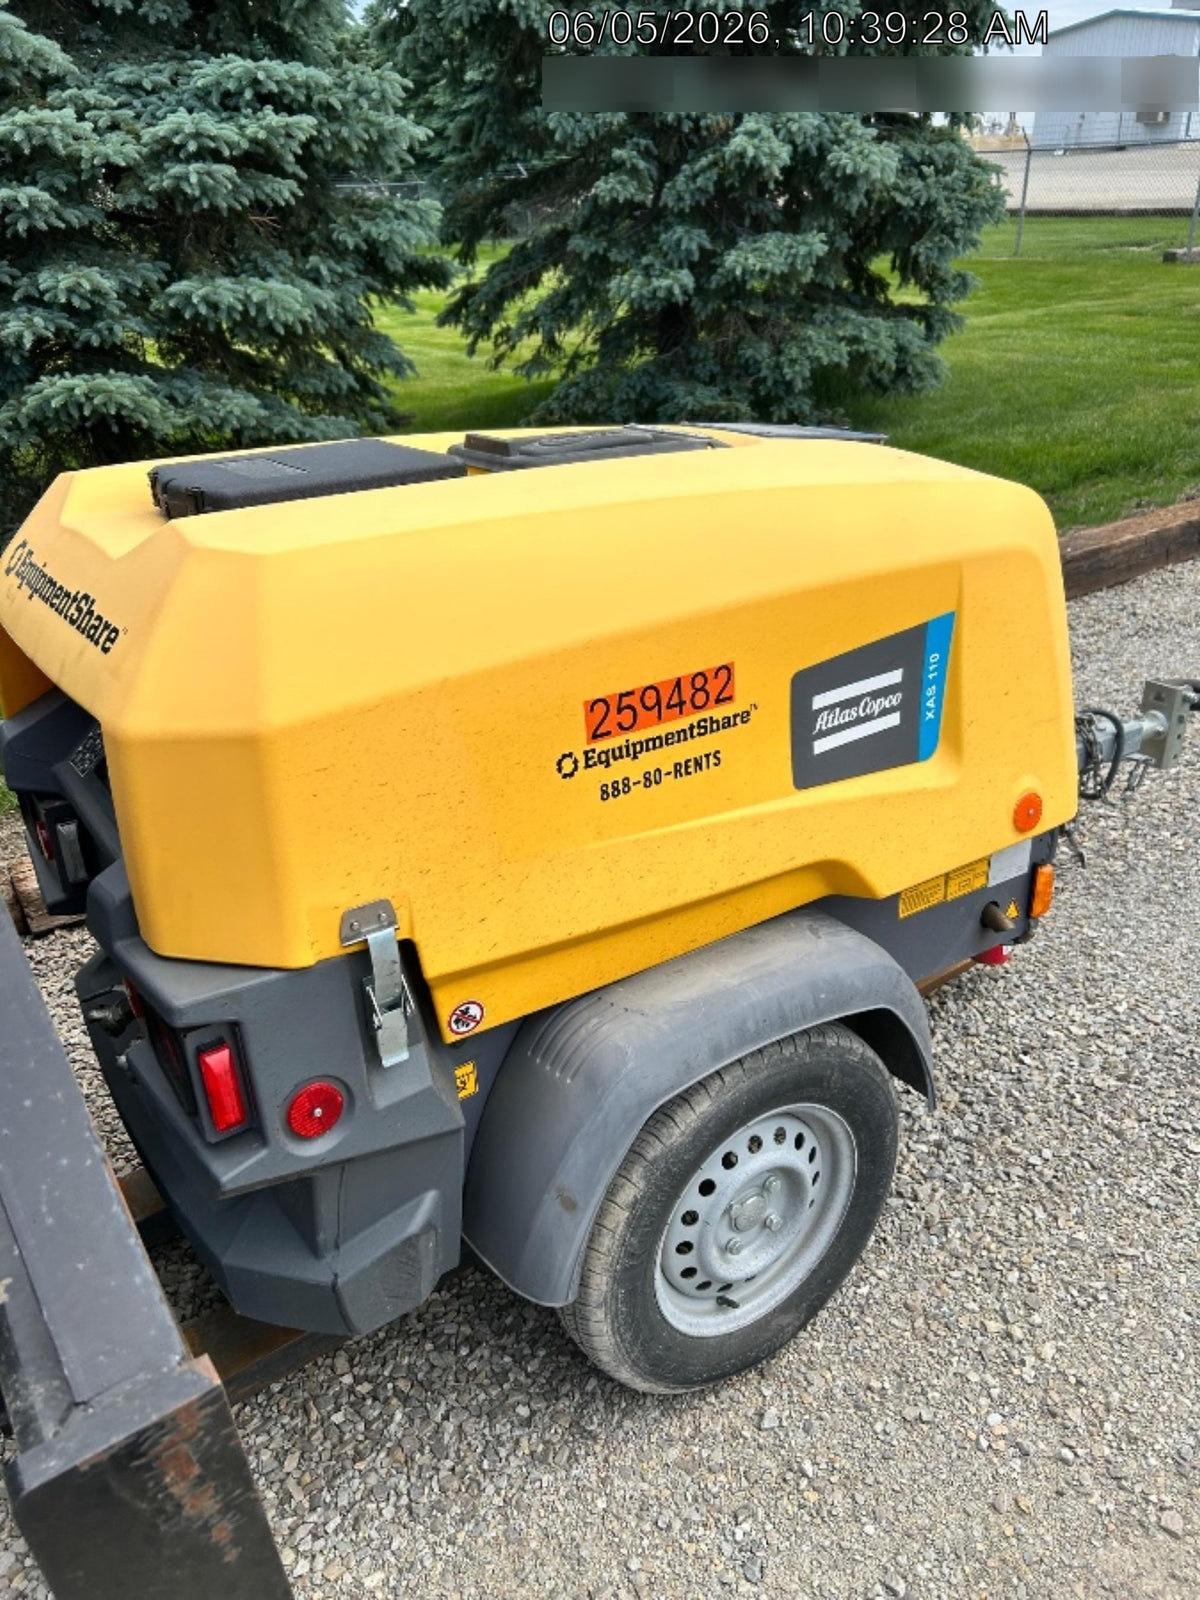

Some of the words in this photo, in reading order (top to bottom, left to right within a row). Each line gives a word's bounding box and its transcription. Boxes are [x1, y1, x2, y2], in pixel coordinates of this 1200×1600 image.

[927, 653, 940, 681] 110
[588, 663, 734, 741] 259482
[925, 685, 937, 722] XAS
[599, 749, 721, 802] 888-80-RENTS
